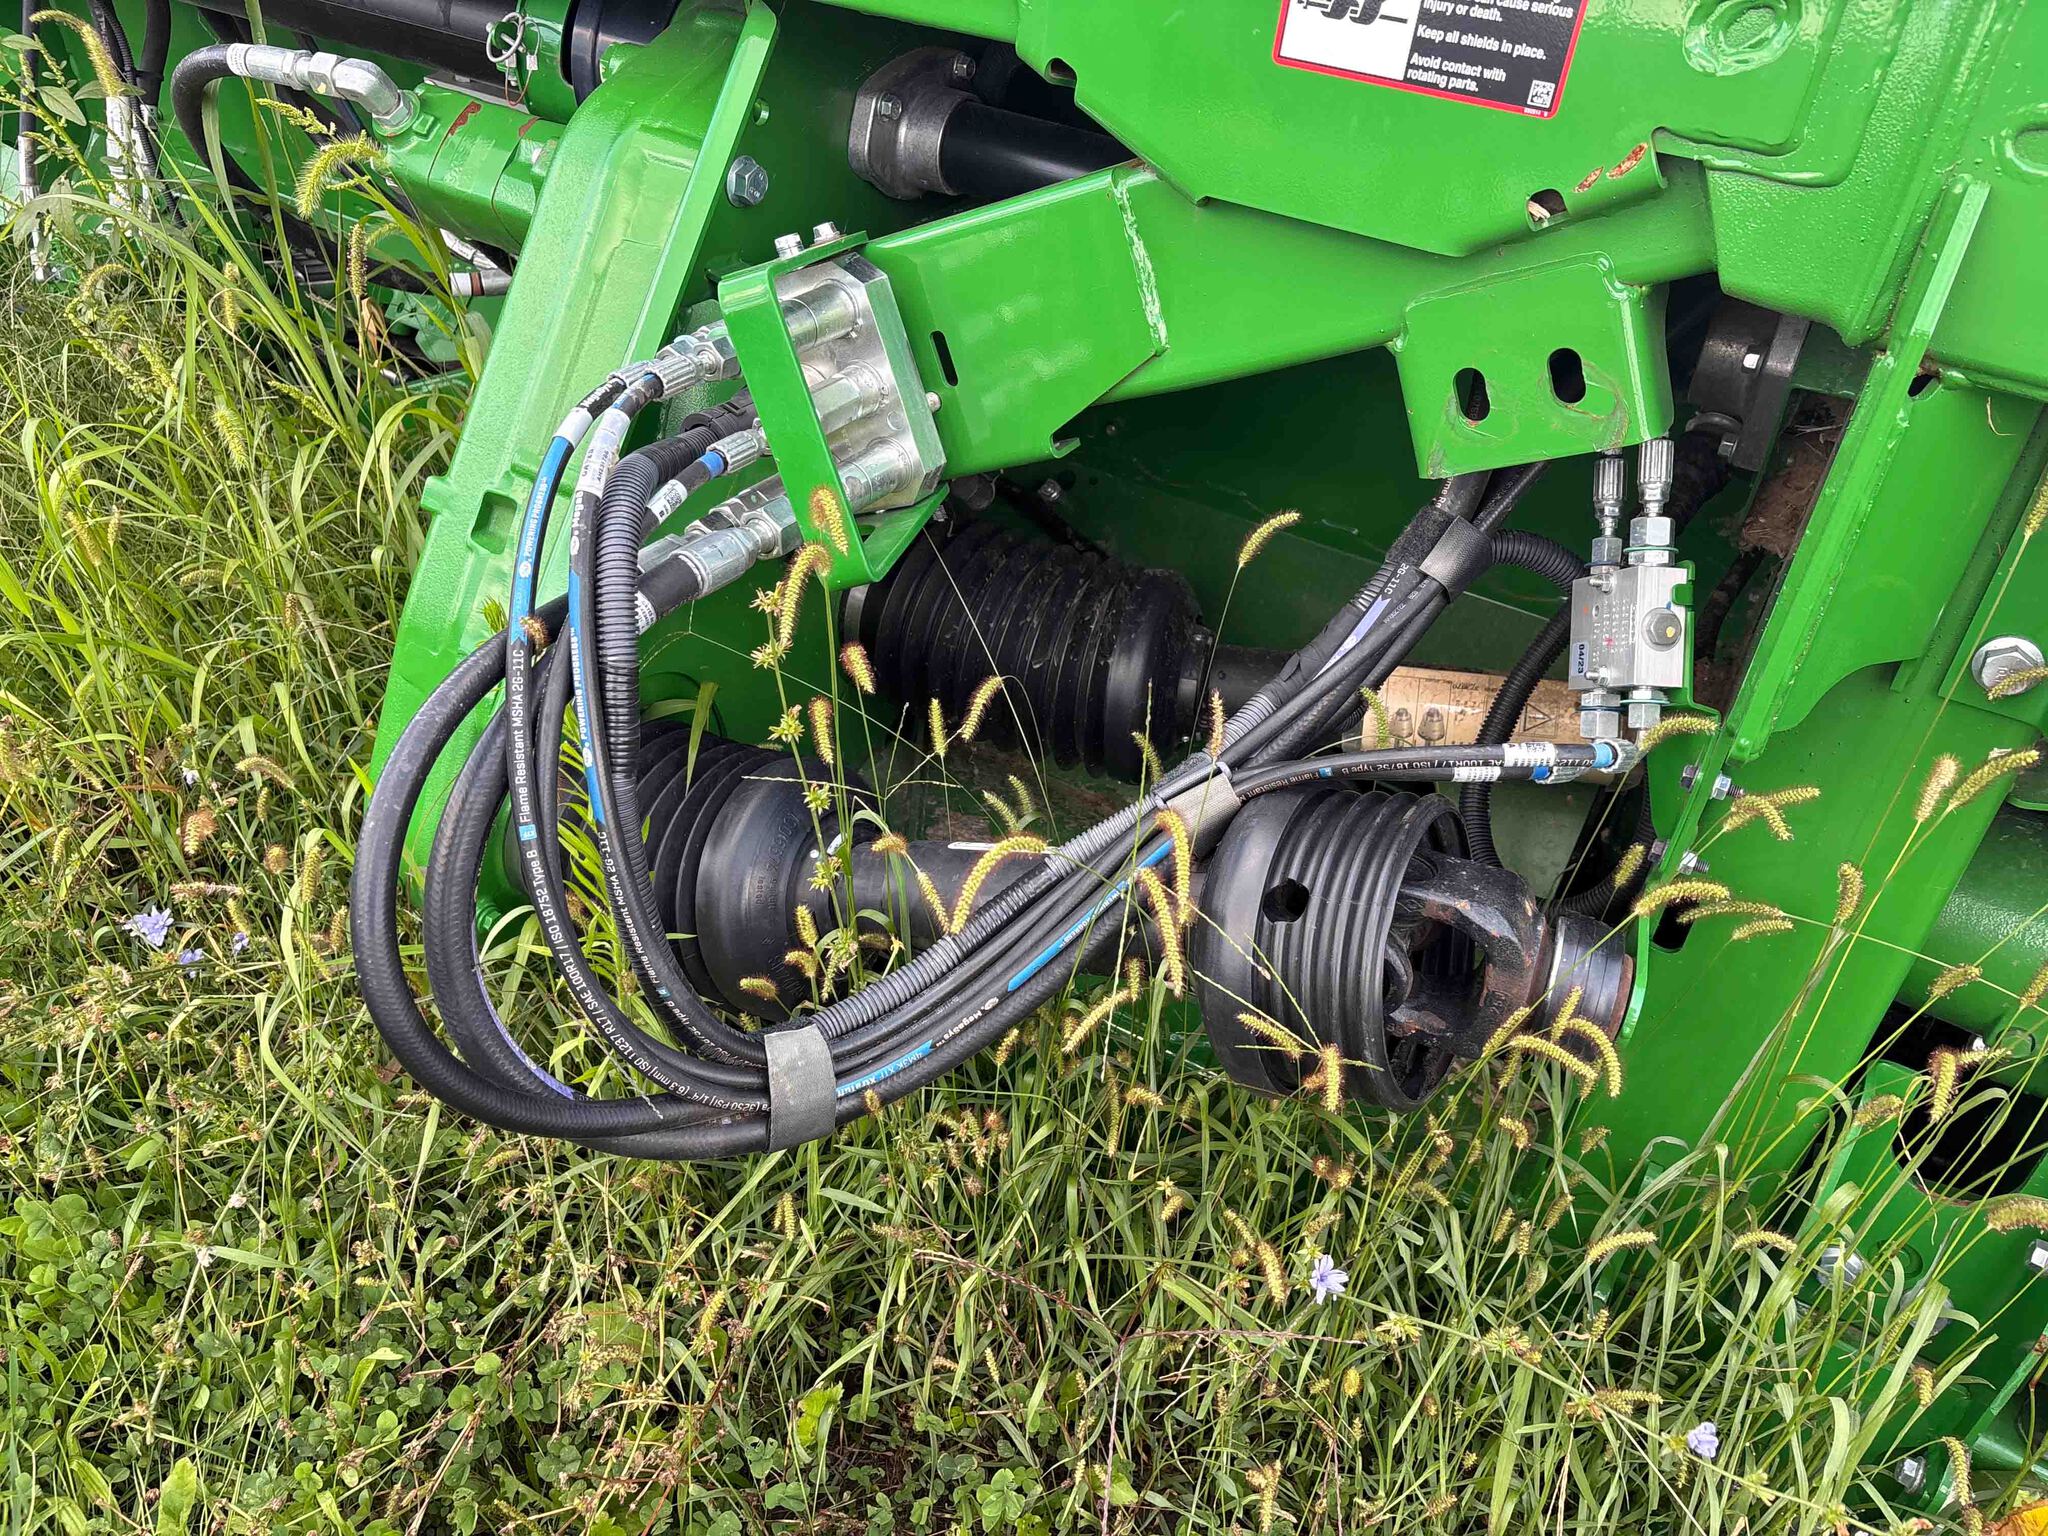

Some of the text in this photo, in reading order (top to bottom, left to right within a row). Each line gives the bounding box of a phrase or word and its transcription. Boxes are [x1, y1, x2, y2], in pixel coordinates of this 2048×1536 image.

[1423, 0, 1503, 22] injury or death.
[1530, 2, 1574, 19] serious
[1416, 24, 1547, 60] Keep all shields in place.
[1406, 68, 1479, 92] rotating parts.
[1410, 52, 1507, 82] Avoid contact with
[511, 649, 524, 692] 2G-11C
[1577, 643, 1585, 674] 04/23
[511, 693, 524, 730] MSHA
[574, 687, 589, 740] POWERING
[511, 730, 527, 785] Resistant
[1249, 778, 1290, 798] Resistant
[1290, 771, 1320, 783] Flame
[516, 787, 531, 823] Flame
[526, 849, 538, 859] B
[598, 831, 617, 873] 2G-11C
[530, 861, 545, 887] Type
[608, 875, 627, 905] MSHA
[536, 887, 557, 924] 18752
[548, 925, 564, 944] ISO
[620, 907, 648, 955] Resistant
[559, 953, 587, 991] 100R17
[641, 955, 660, 984] Flame
[580, 989, 599, 1010] SAE
[596, 1016, 617, 1035] R17
[610, 1034, 637, 1060] 11237
[898, 1052, 923, 1070] 4M3K
[633, 1057, 652, 1072] ISO
